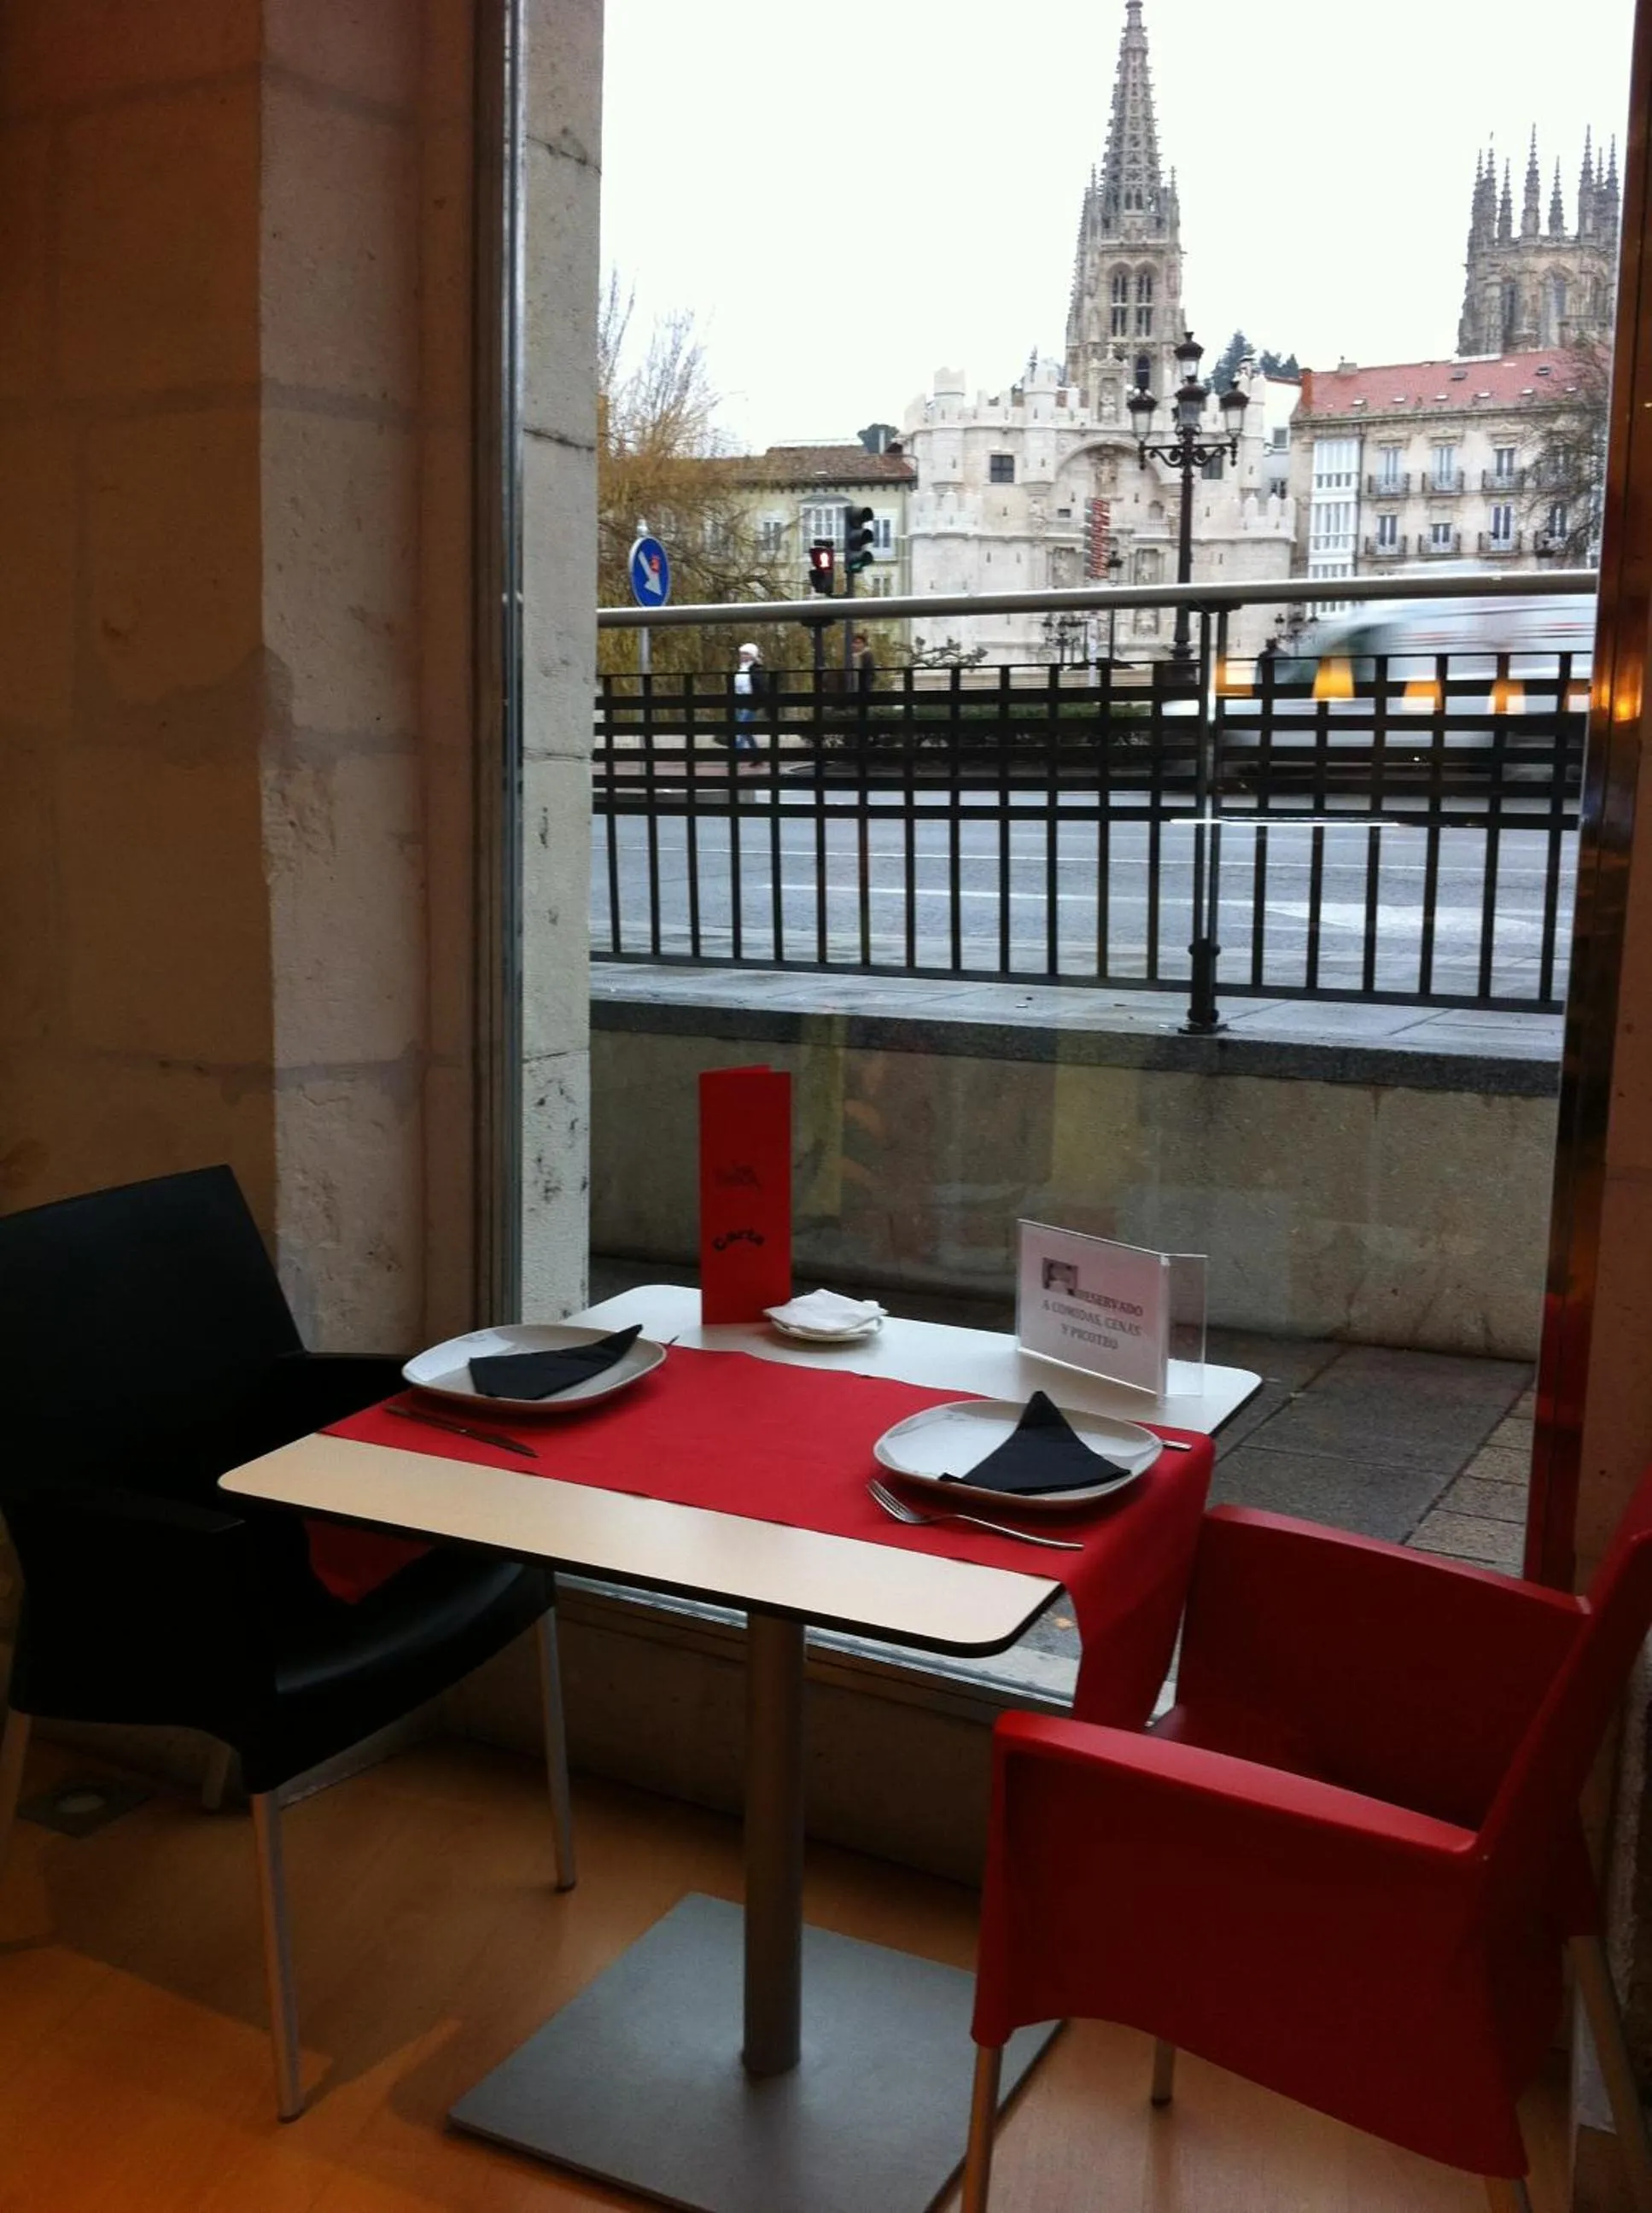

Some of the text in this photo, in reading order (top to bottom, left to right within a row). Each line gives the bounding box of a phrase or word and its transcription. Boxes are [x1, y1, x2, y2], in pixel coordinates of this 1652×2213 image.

[1042, 1299, 1050, 1311] A
[1105, 1317, 1143, 1337] CENAS
[1060, 1323, 1119, 1350] Y PICOTEO
